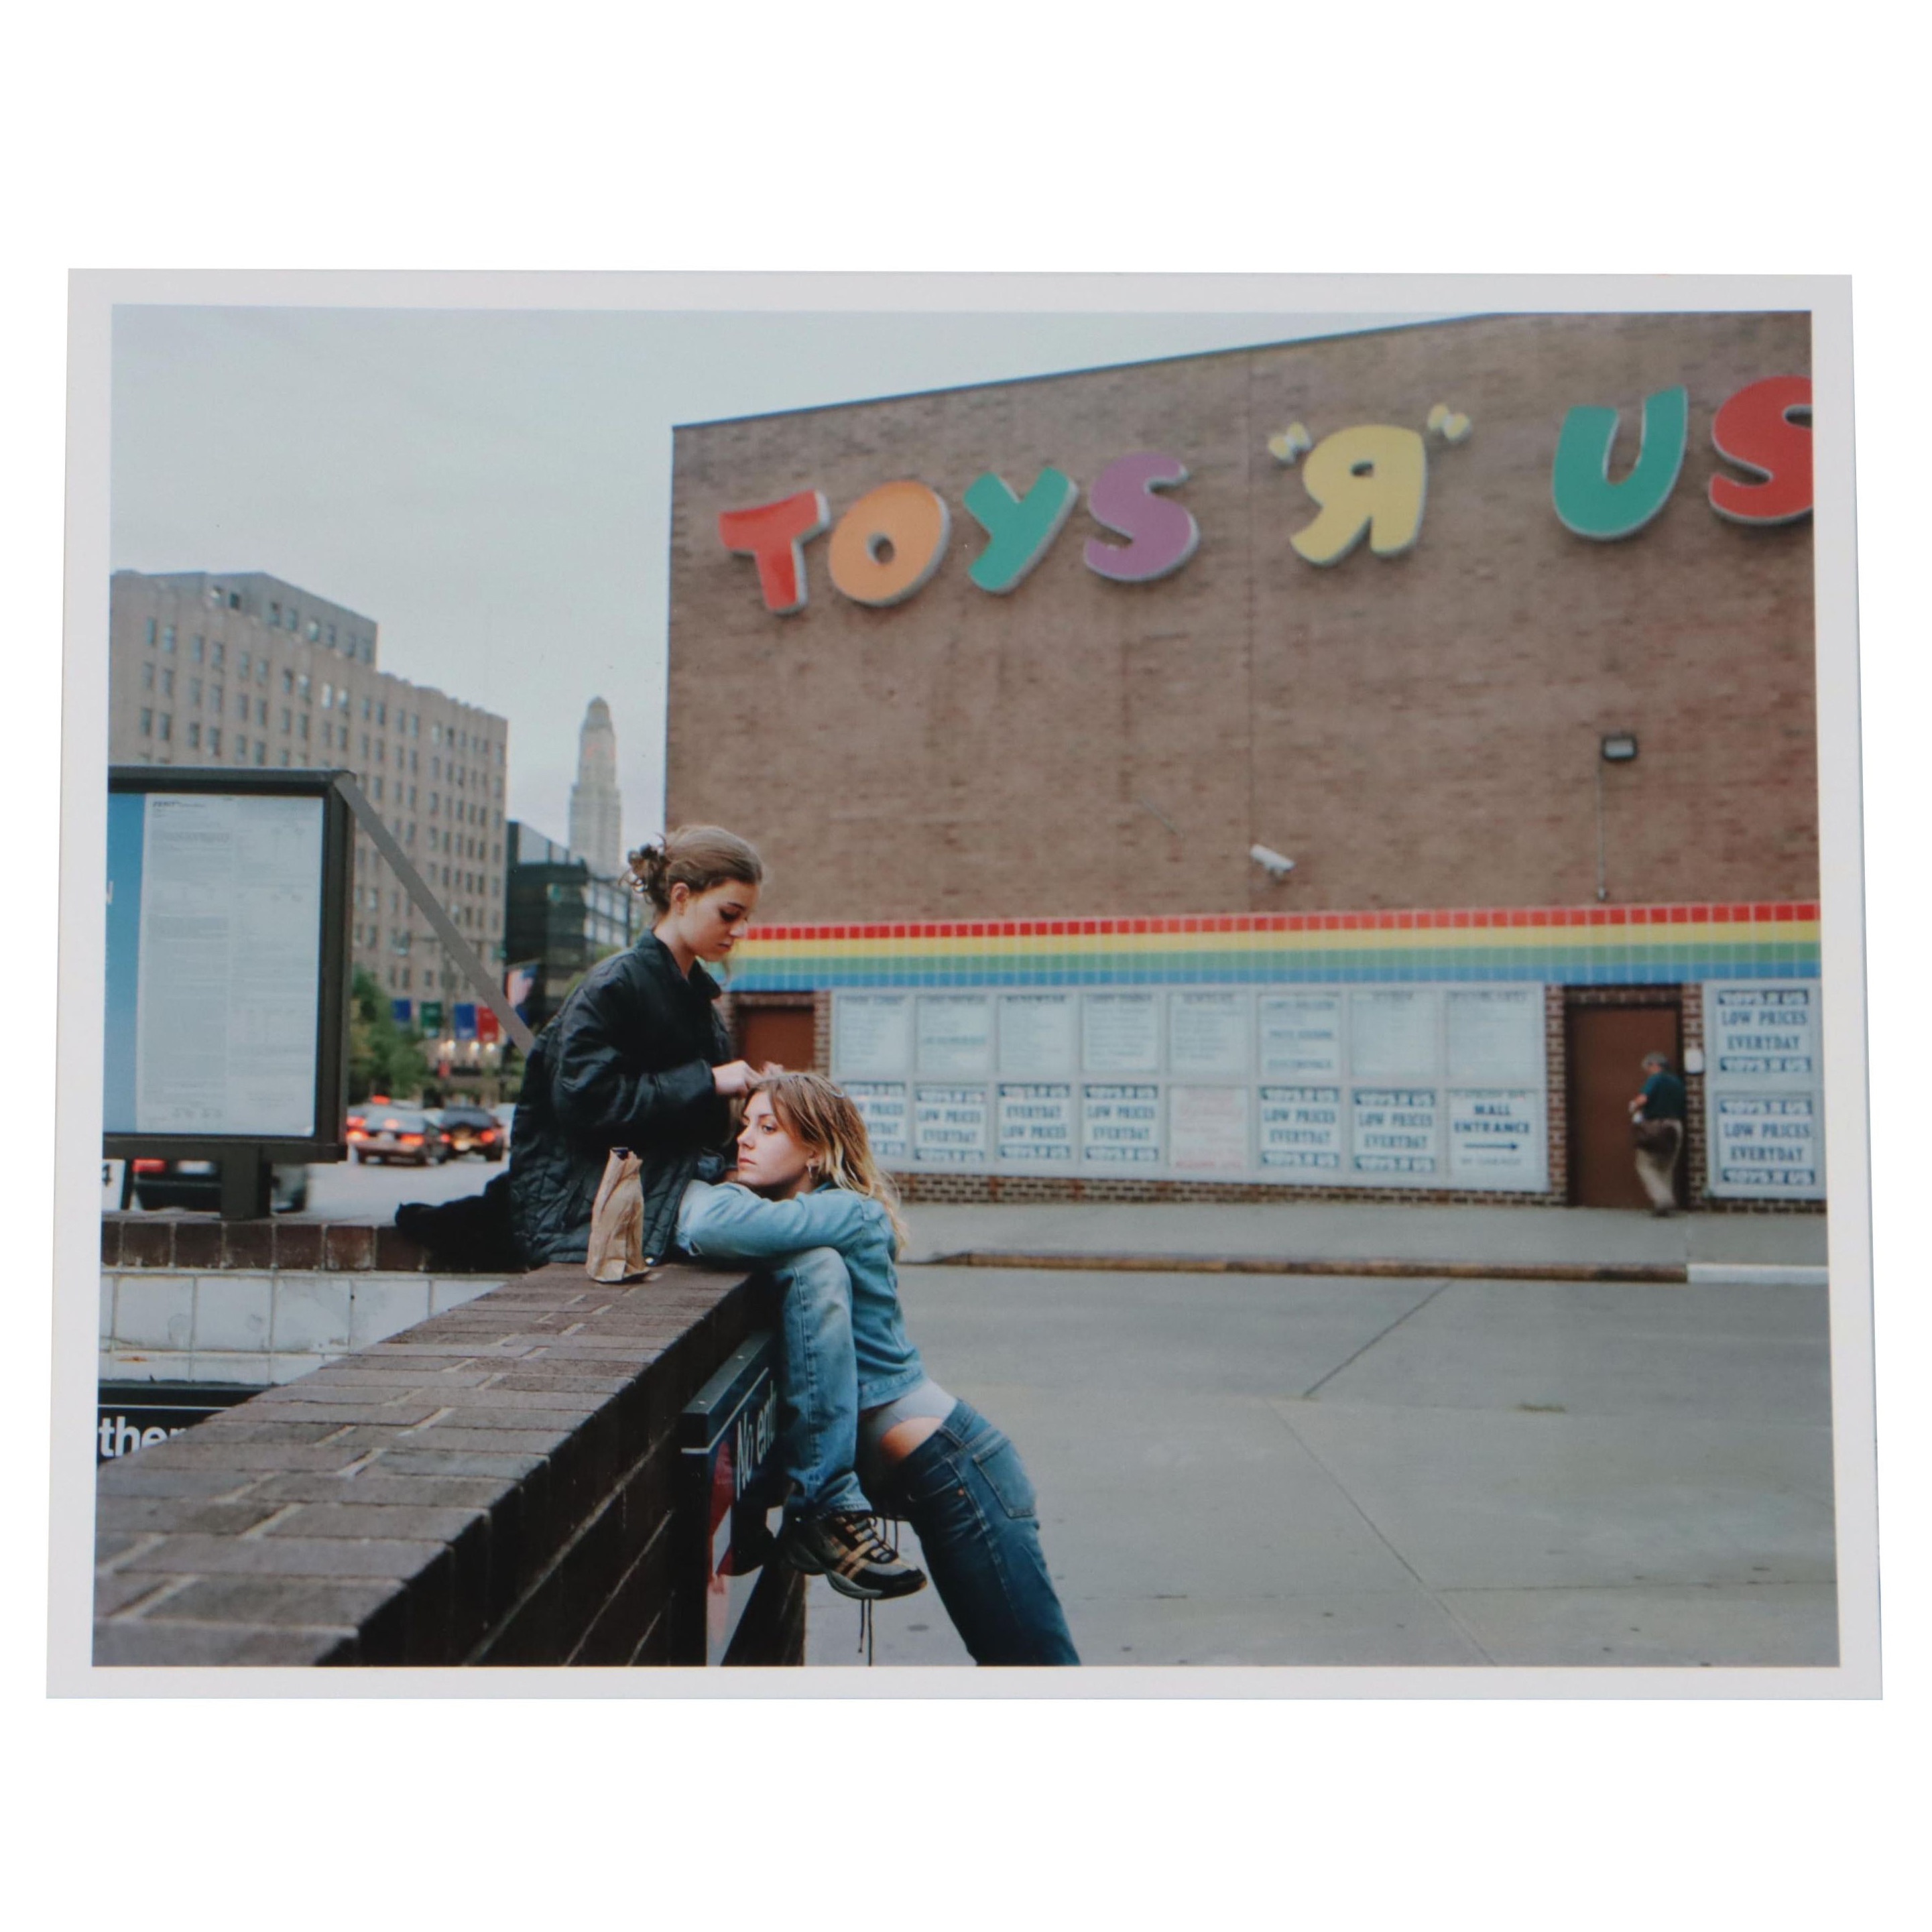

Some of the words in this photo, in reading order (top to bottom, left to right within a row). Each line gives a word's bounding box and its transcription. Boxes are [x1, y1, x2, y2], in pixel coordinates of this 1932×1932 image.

[719, 451, 1200, 615] TOYS
[1552, 375, 1813, 540] US
[1722, 1010, 1752, 1026] LOW
[1454, 1121, 1530, 1134] ENTRANCE
[1724, 1122, 1754, 1138] LOW
[737, 1410, 754, 1502] No
